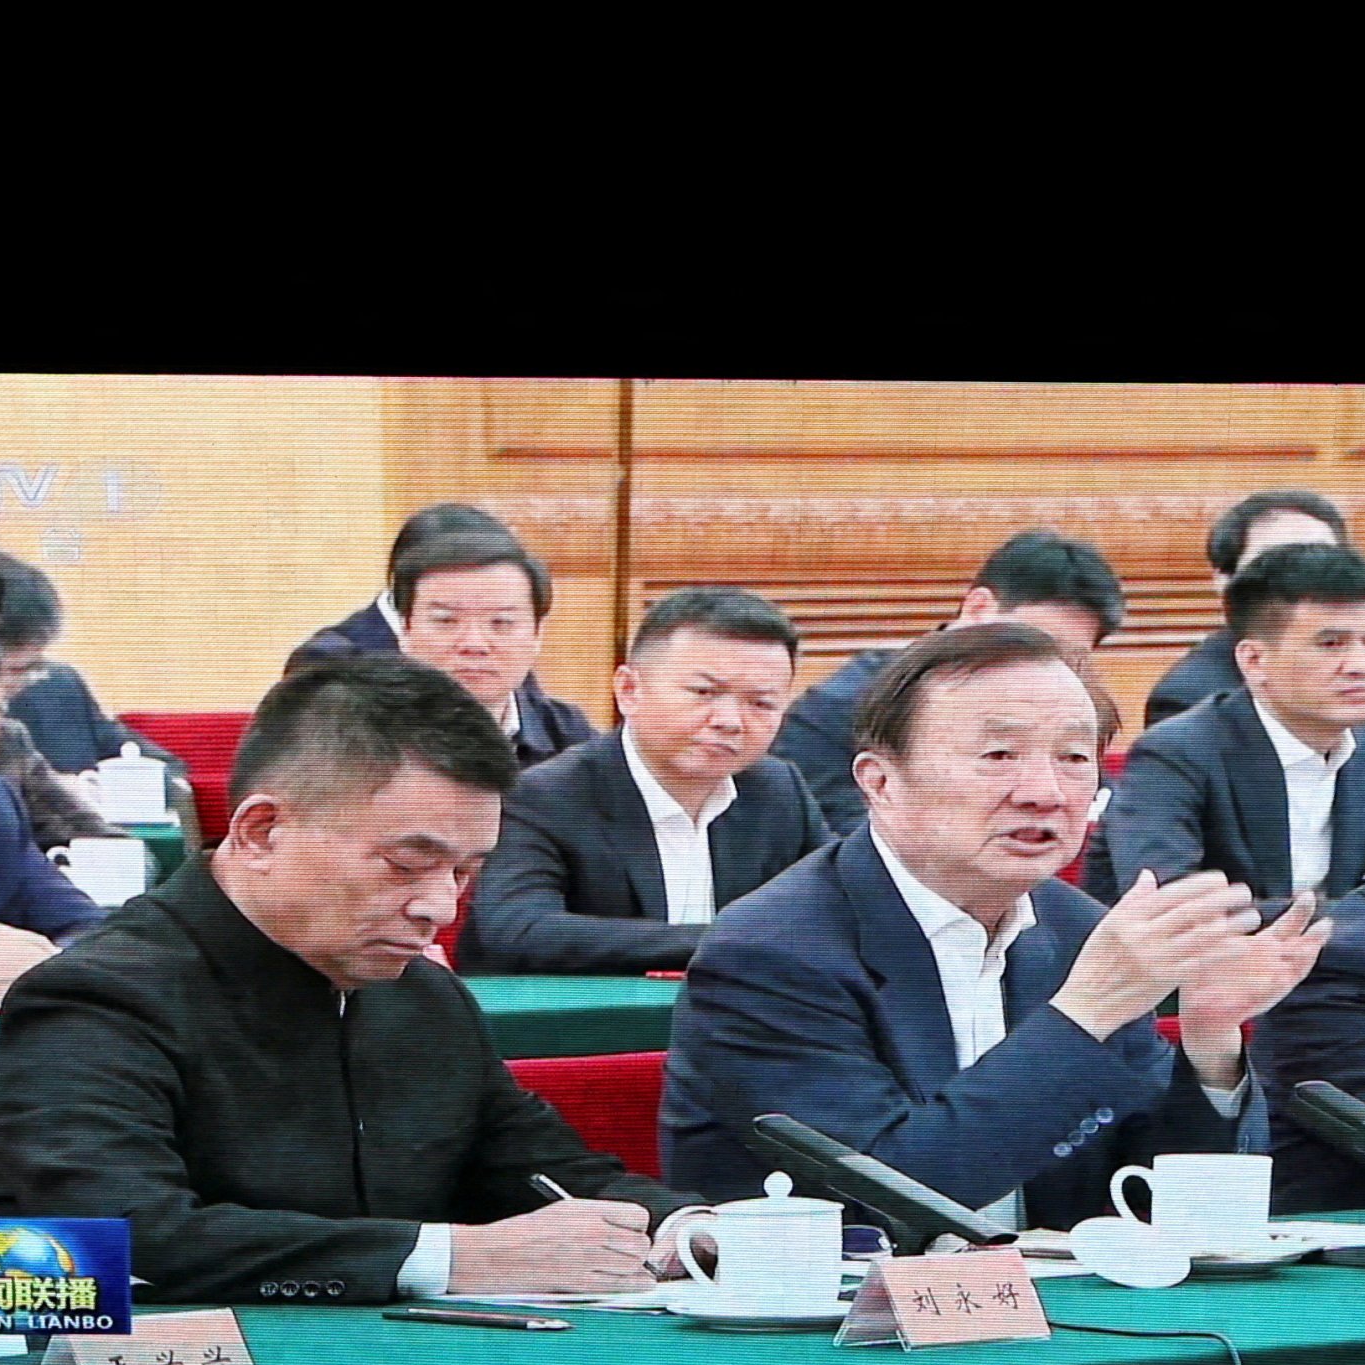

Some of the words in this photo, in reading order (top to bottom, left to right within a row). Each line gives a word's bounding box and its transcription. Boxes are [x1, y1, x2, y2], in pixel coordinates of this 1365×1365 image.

[912, 1282, 1020, 1315] 刘永好
[28, 1314, 114, 1331] LIANBO
